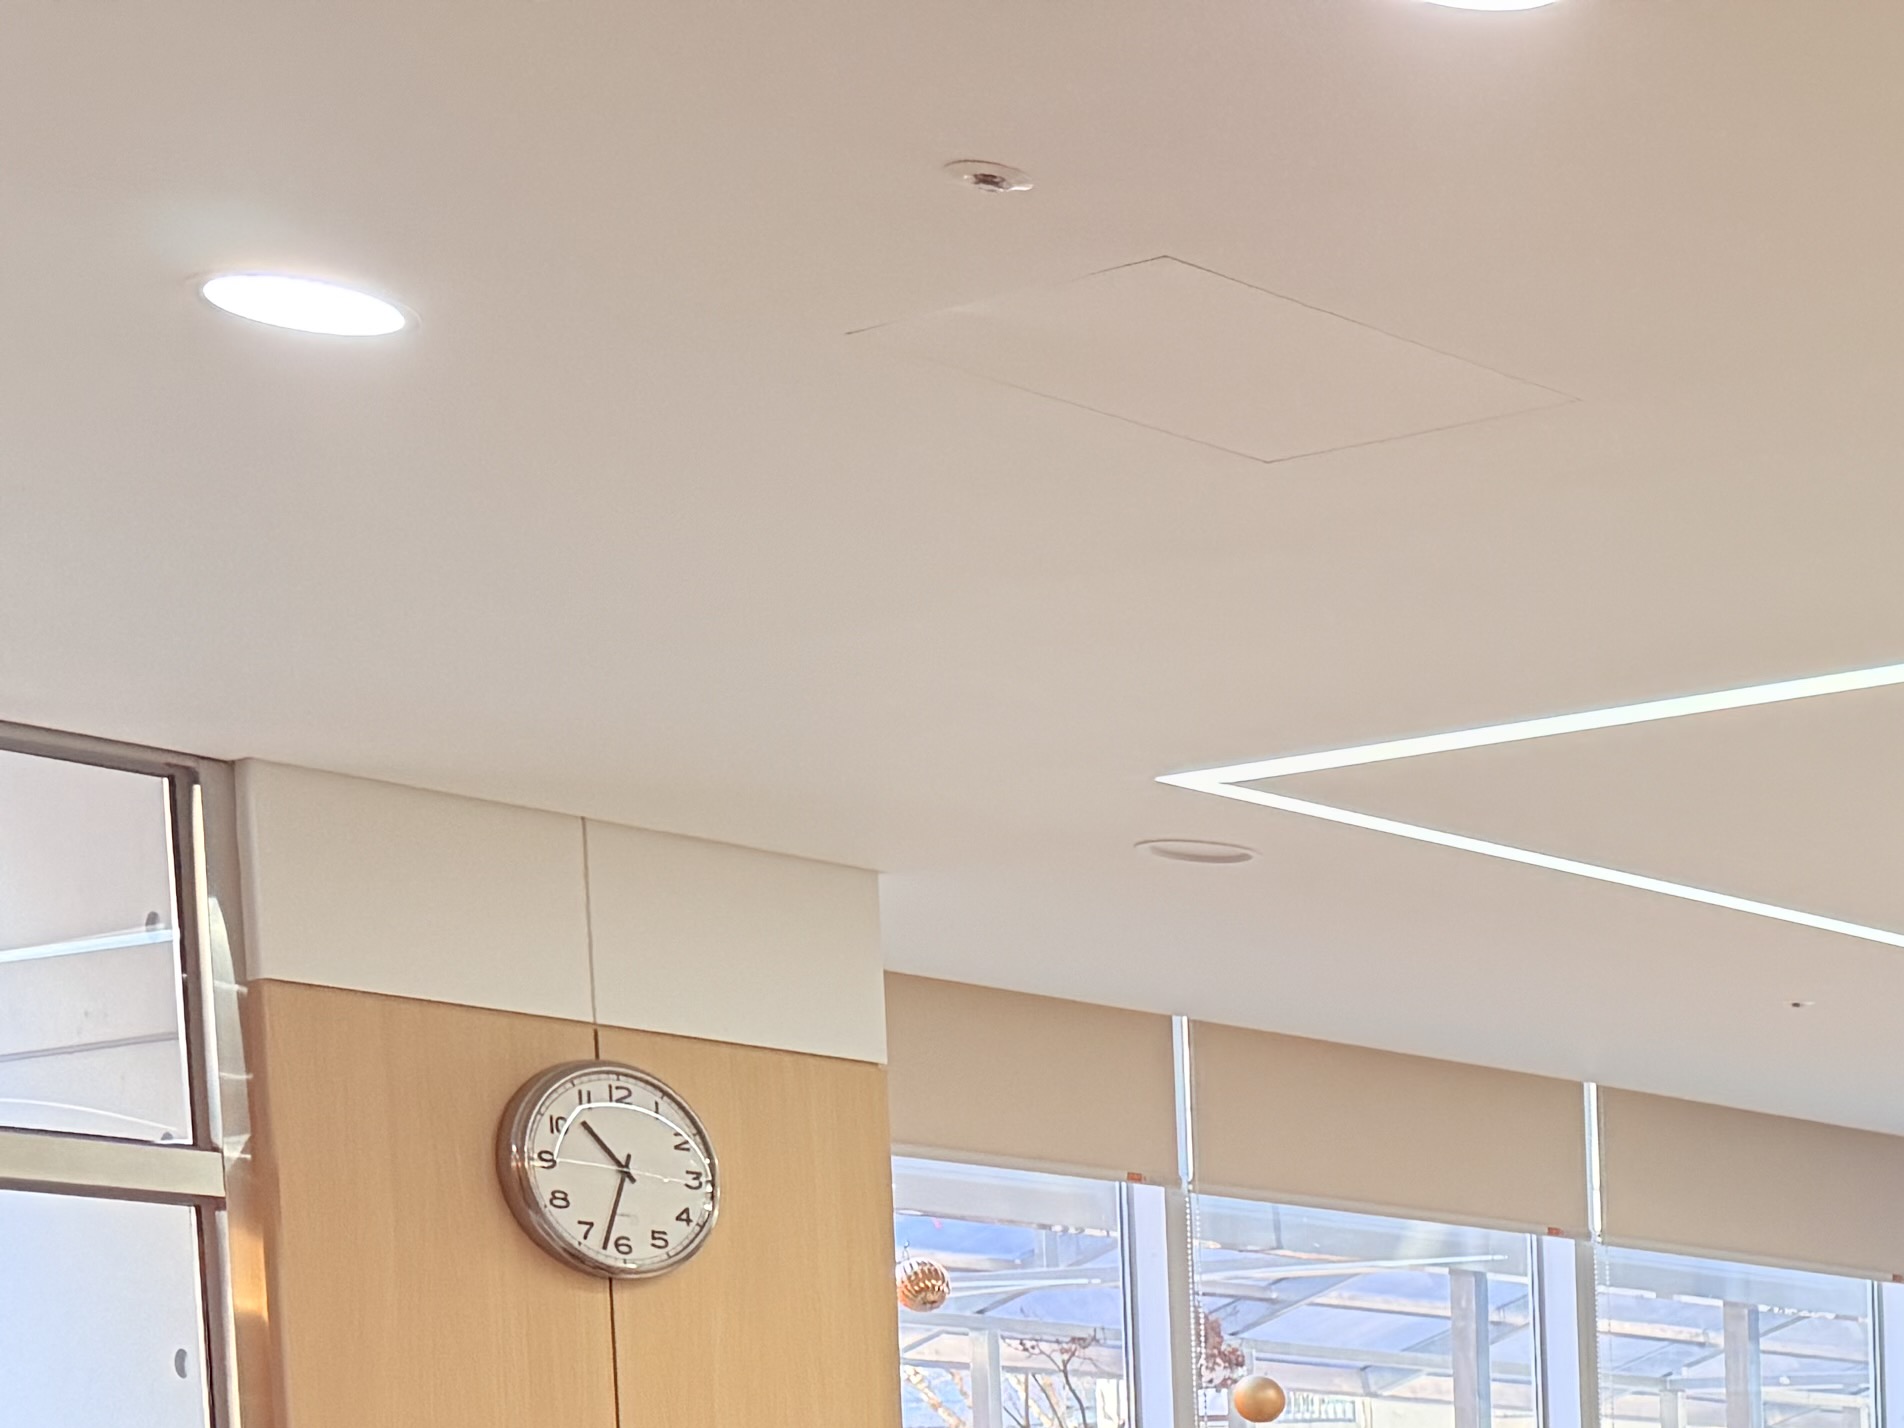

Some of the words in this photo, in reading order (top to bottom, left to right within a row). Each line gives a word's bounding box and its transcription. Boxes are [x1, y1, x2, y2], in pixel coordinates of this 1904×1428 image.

[578, 1089, 592, 1111] 11
[608, 1084, 633, 1106] 12
[549, 1115, 569, 1137] 10
[673, 1131, 692, 1152] 2
[536, 1150, 558, 1170] 9
[684, 1170, 704, 1191] 3
[549, 1190, 571, 1209] 8
[675, 1207, 693, 1227] 4
[577, 1220, 595, 1241] 7
[650, 1230, 669, 1249] 5
[613, 1236, 633, 1255] 6
